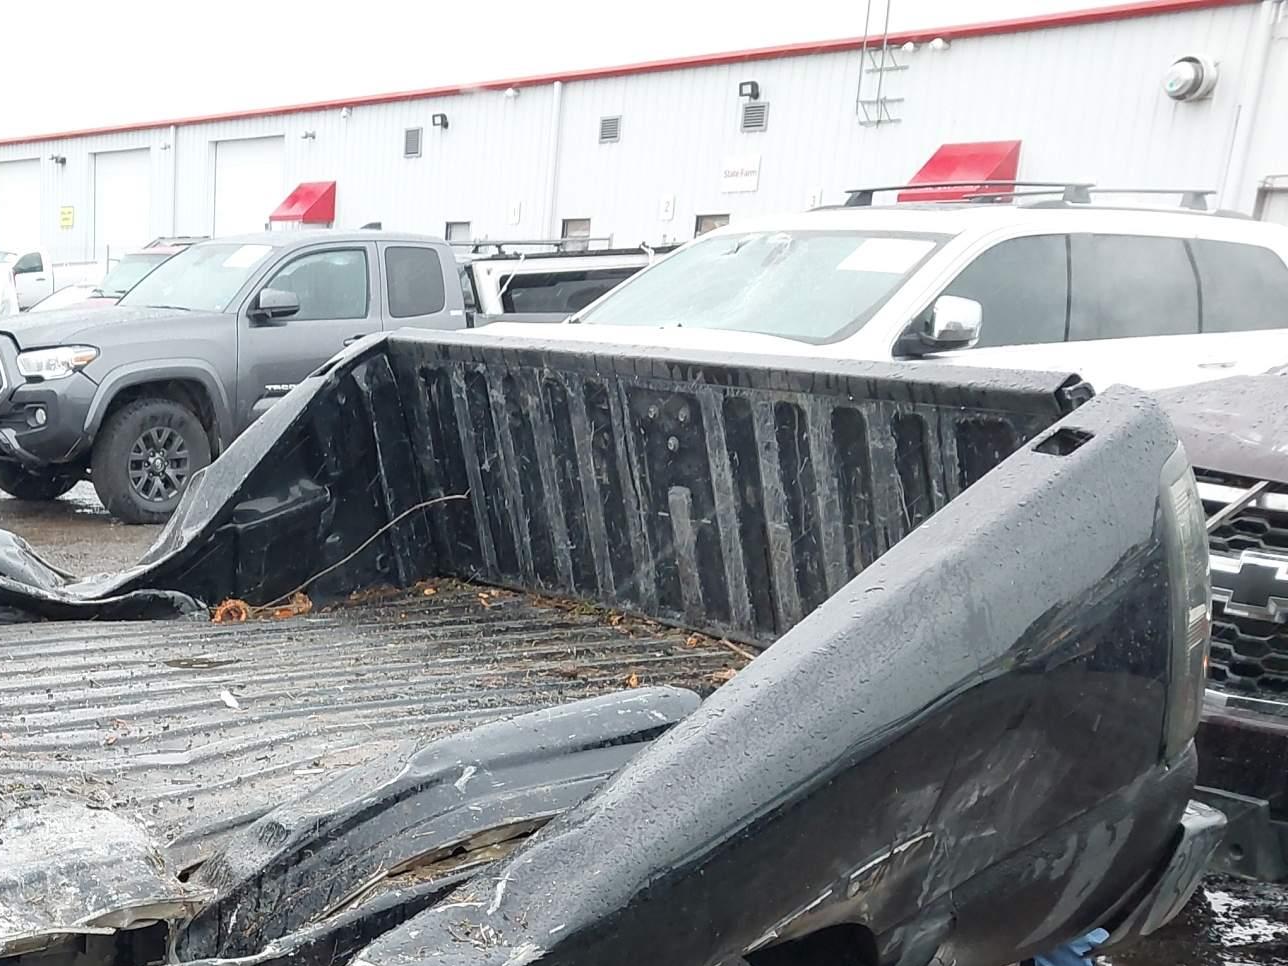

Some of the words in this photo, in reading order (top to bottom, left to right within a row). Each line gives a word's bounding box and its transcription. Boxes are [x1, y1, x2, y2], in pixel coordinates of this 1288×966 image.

[723, 168, 740, 178] State
[740, 168, 758, 177] Farm
[664, 200, 671, 213] 2
